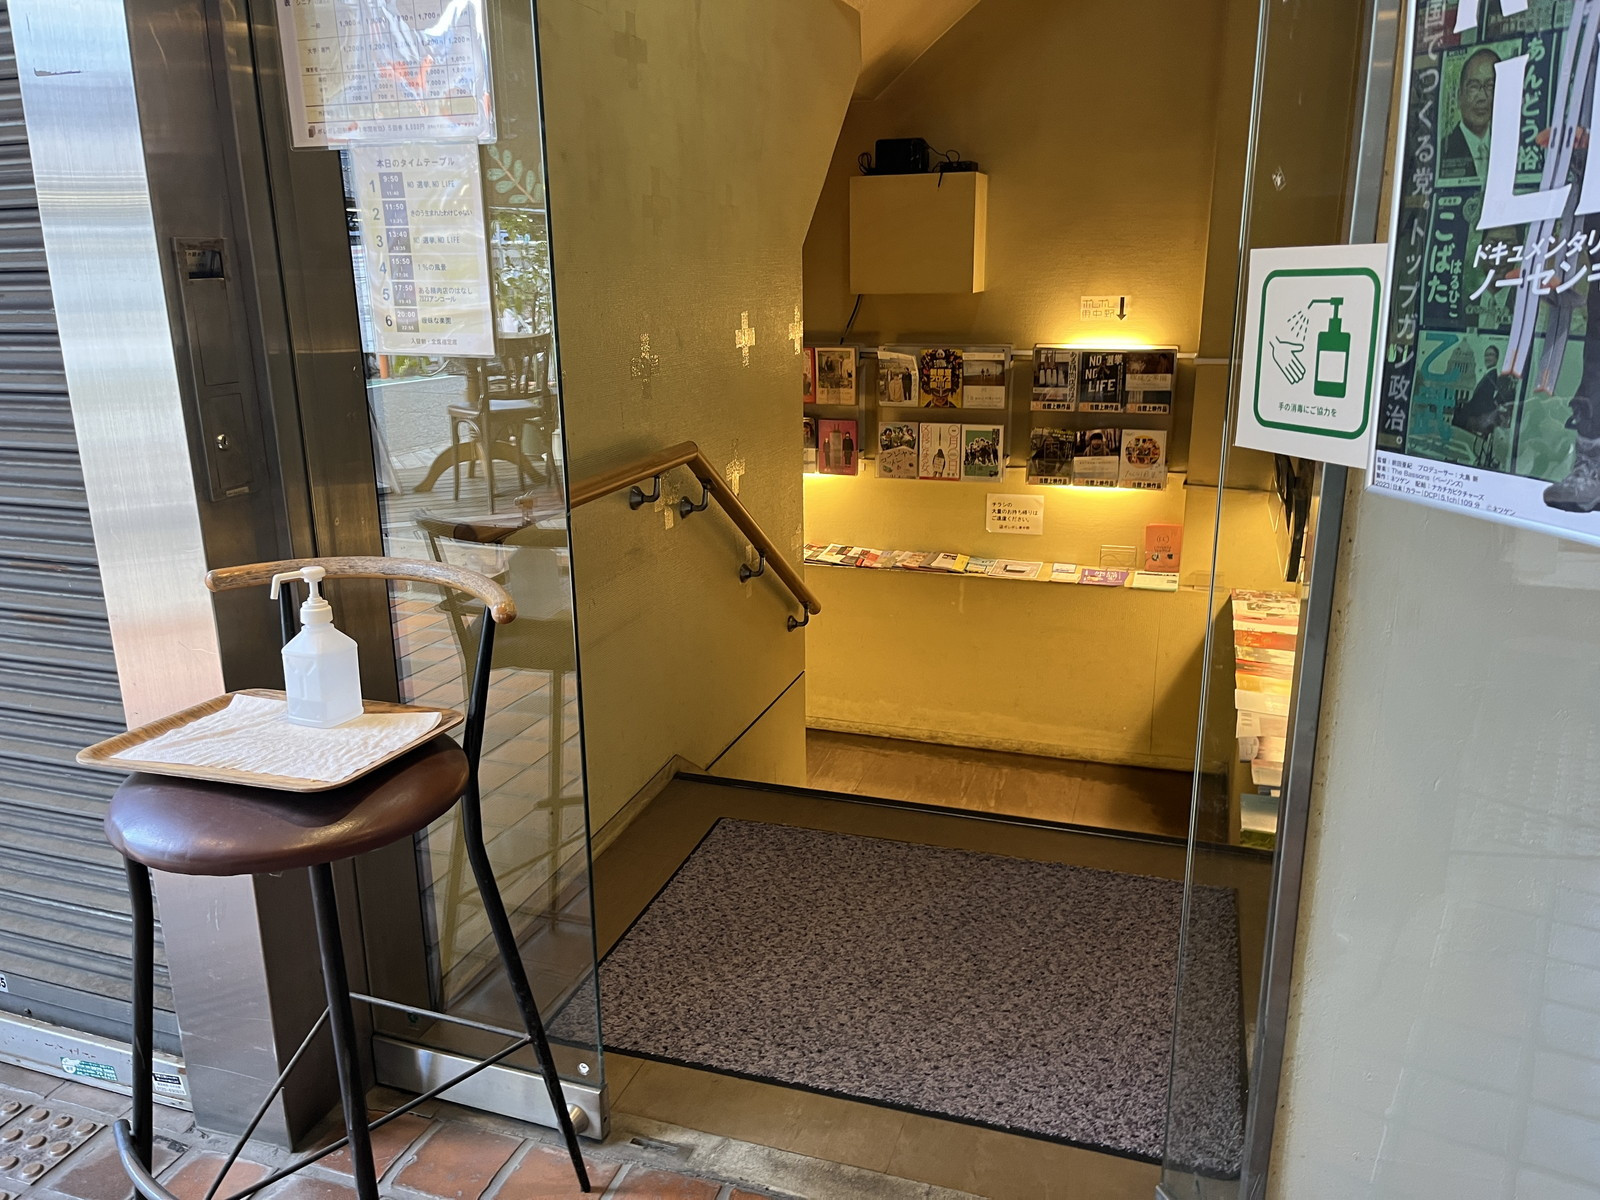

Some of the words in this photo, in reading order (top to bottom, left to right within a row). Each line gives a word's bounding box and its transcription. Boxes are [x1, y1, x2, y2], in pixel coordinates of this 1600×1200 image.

[376, 156, 455, 169] 本日のタイムテーブル
[382, 175, 399, 183] 9:50
[369, 180, 376, 193] 1
[385, 203, 404, 211] 11:50
[372, 207, 381, 221] 2
[375, 235, 384, 248] 3
[388, 231, 408, 239] 13:40
[391, 257, 410, 265] 15:50
[1427, 211, 1456, 304] こばた
[380, 262, 387, 275] 4
[382, 288, 390, 301] 5
[394, 284, 413, 292] 17:50
[1448, 259, 1462, 318] はるひこ
[385, 315, 393, 327] 6
[397, 311, 416, 319] 20:00
[1088, 379, 1116, 393] LIFE
[1279, 401, 1337, 418] 手の消毒にご協力を
